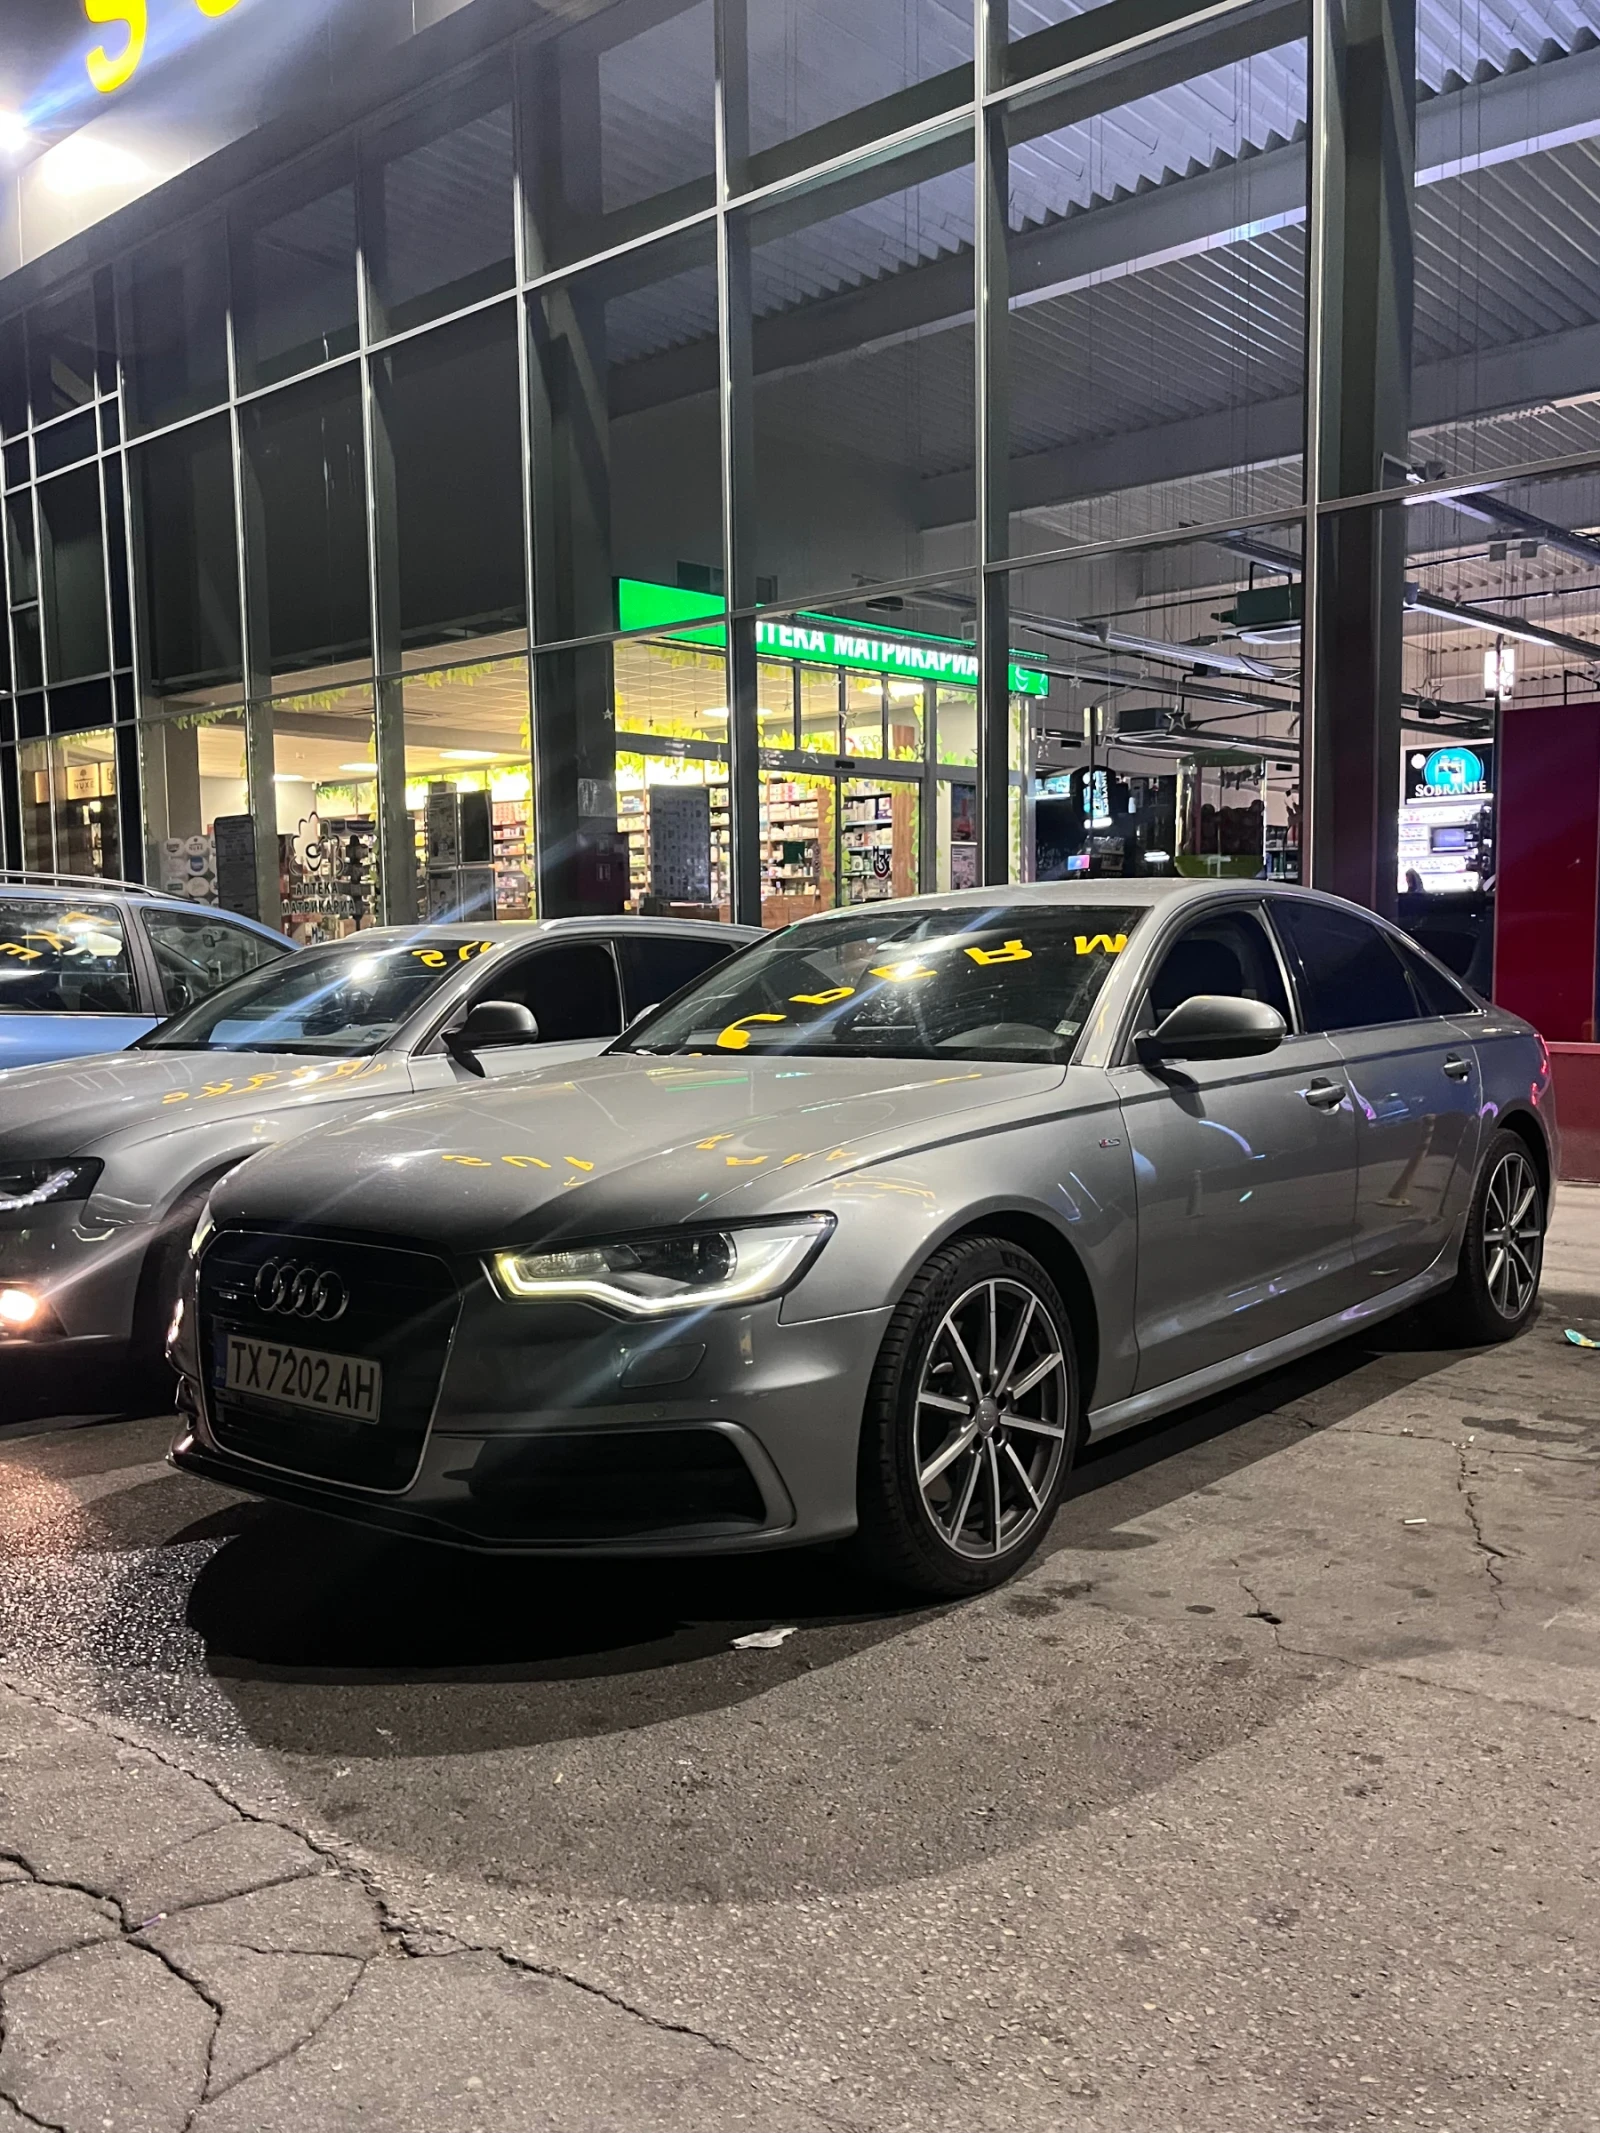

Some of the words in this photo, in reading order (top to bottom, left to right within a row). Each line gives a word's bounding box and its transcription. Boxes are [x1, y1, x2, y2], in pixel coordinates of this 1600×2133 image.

[74, 780, 95, 789] NUXE
[1414, 780, 1487, 797] SOBRANIE
[295, 882, 338, 896] АПТЕКА
